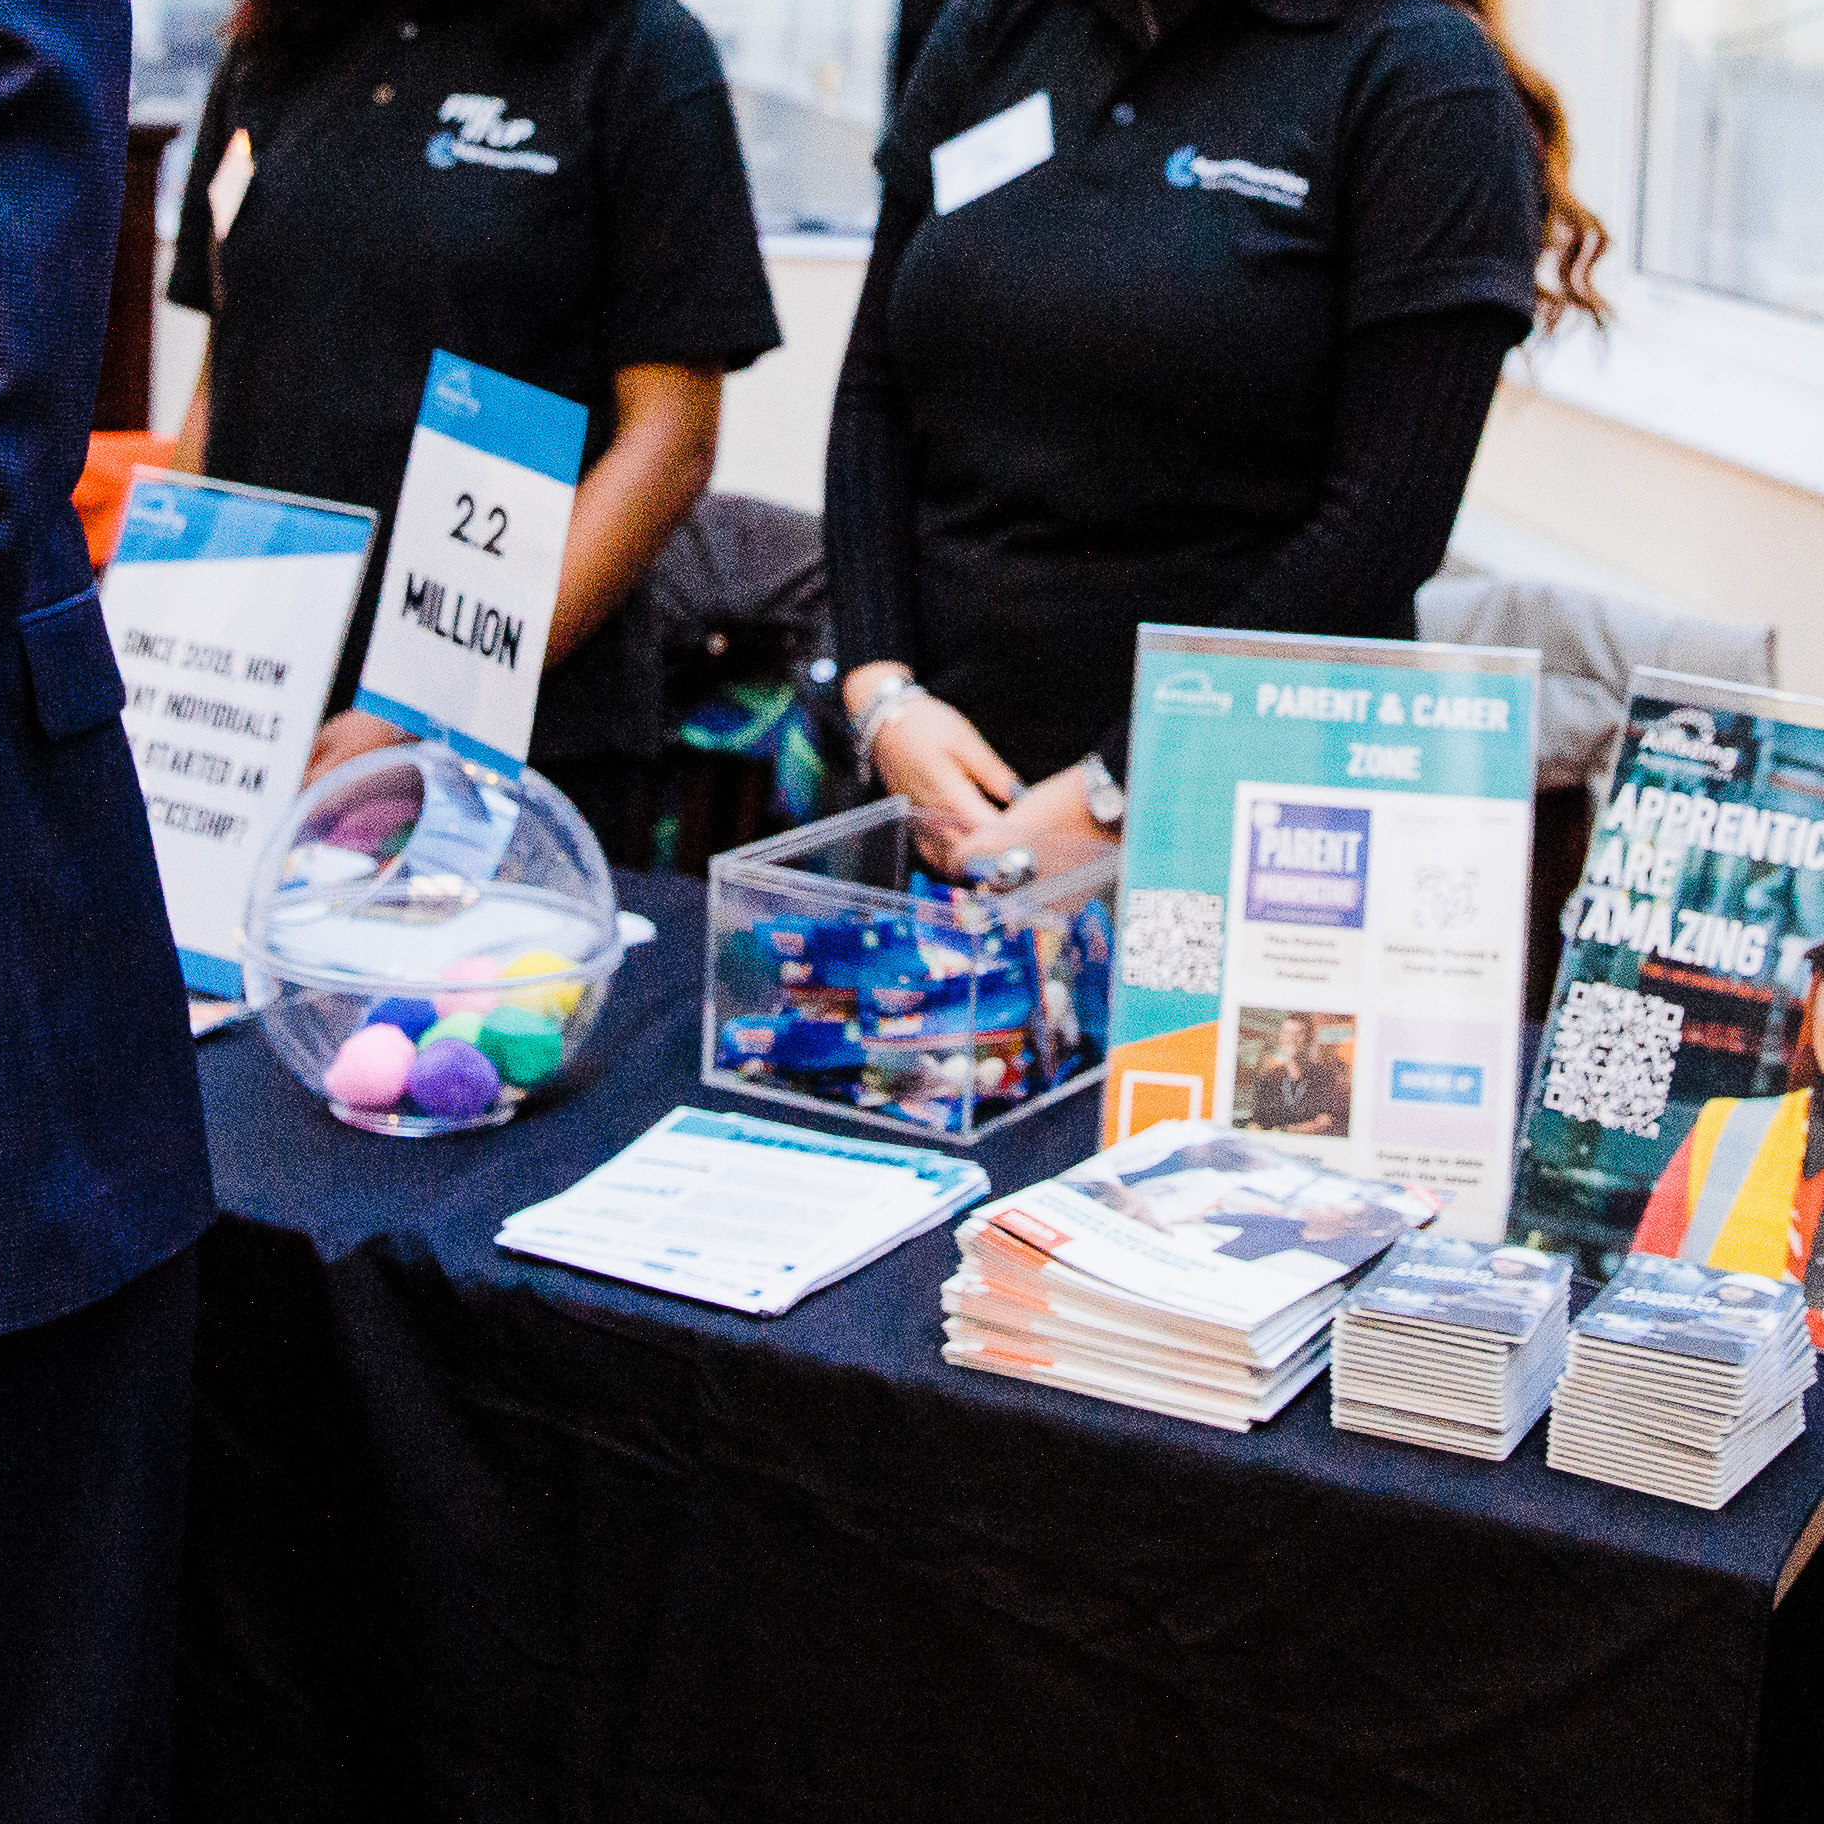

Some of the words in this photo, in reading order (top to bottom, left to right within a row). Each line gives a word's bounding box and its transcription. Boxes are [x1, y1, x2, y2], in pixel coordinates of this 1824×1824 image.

[400, 571, 526, 672] MILLION
[1257, 683, 1372, 724] PARENT
[1378, 693, 1405, 725] &
[1412, 696, 1510, 732] CARER
[1346, 742, 1422, 779] ZONE
[1257, 829, 1362, 872] PARENT
[1586, 842, 1680, 896] ARE
[1578, 888, 1767, 977] AMAZING
